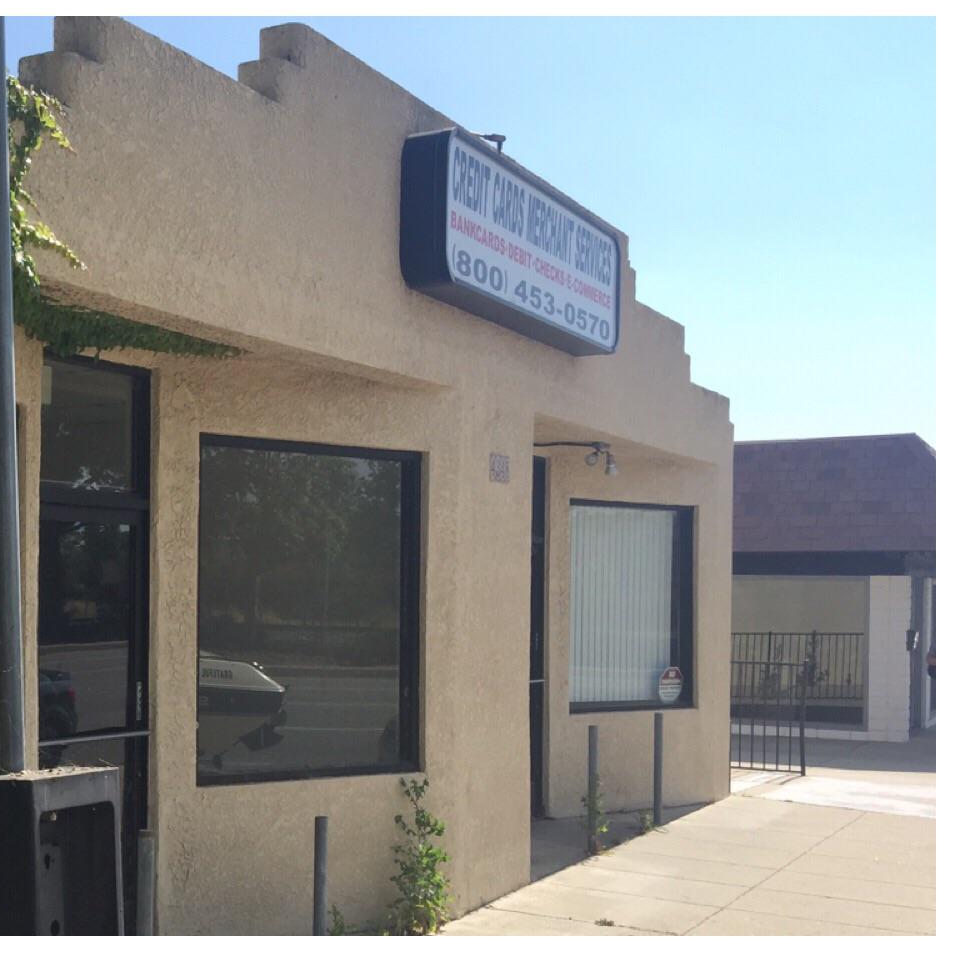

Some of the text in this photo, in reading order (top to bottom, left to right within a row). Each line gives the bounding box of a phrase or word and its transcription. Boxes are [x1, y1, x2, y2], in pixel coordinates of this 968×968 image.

[452, 146, 612, 287] CREDIT CARDS MERCHANT SERVICES
[451, 242, 611, 341] (800) 453-0570
